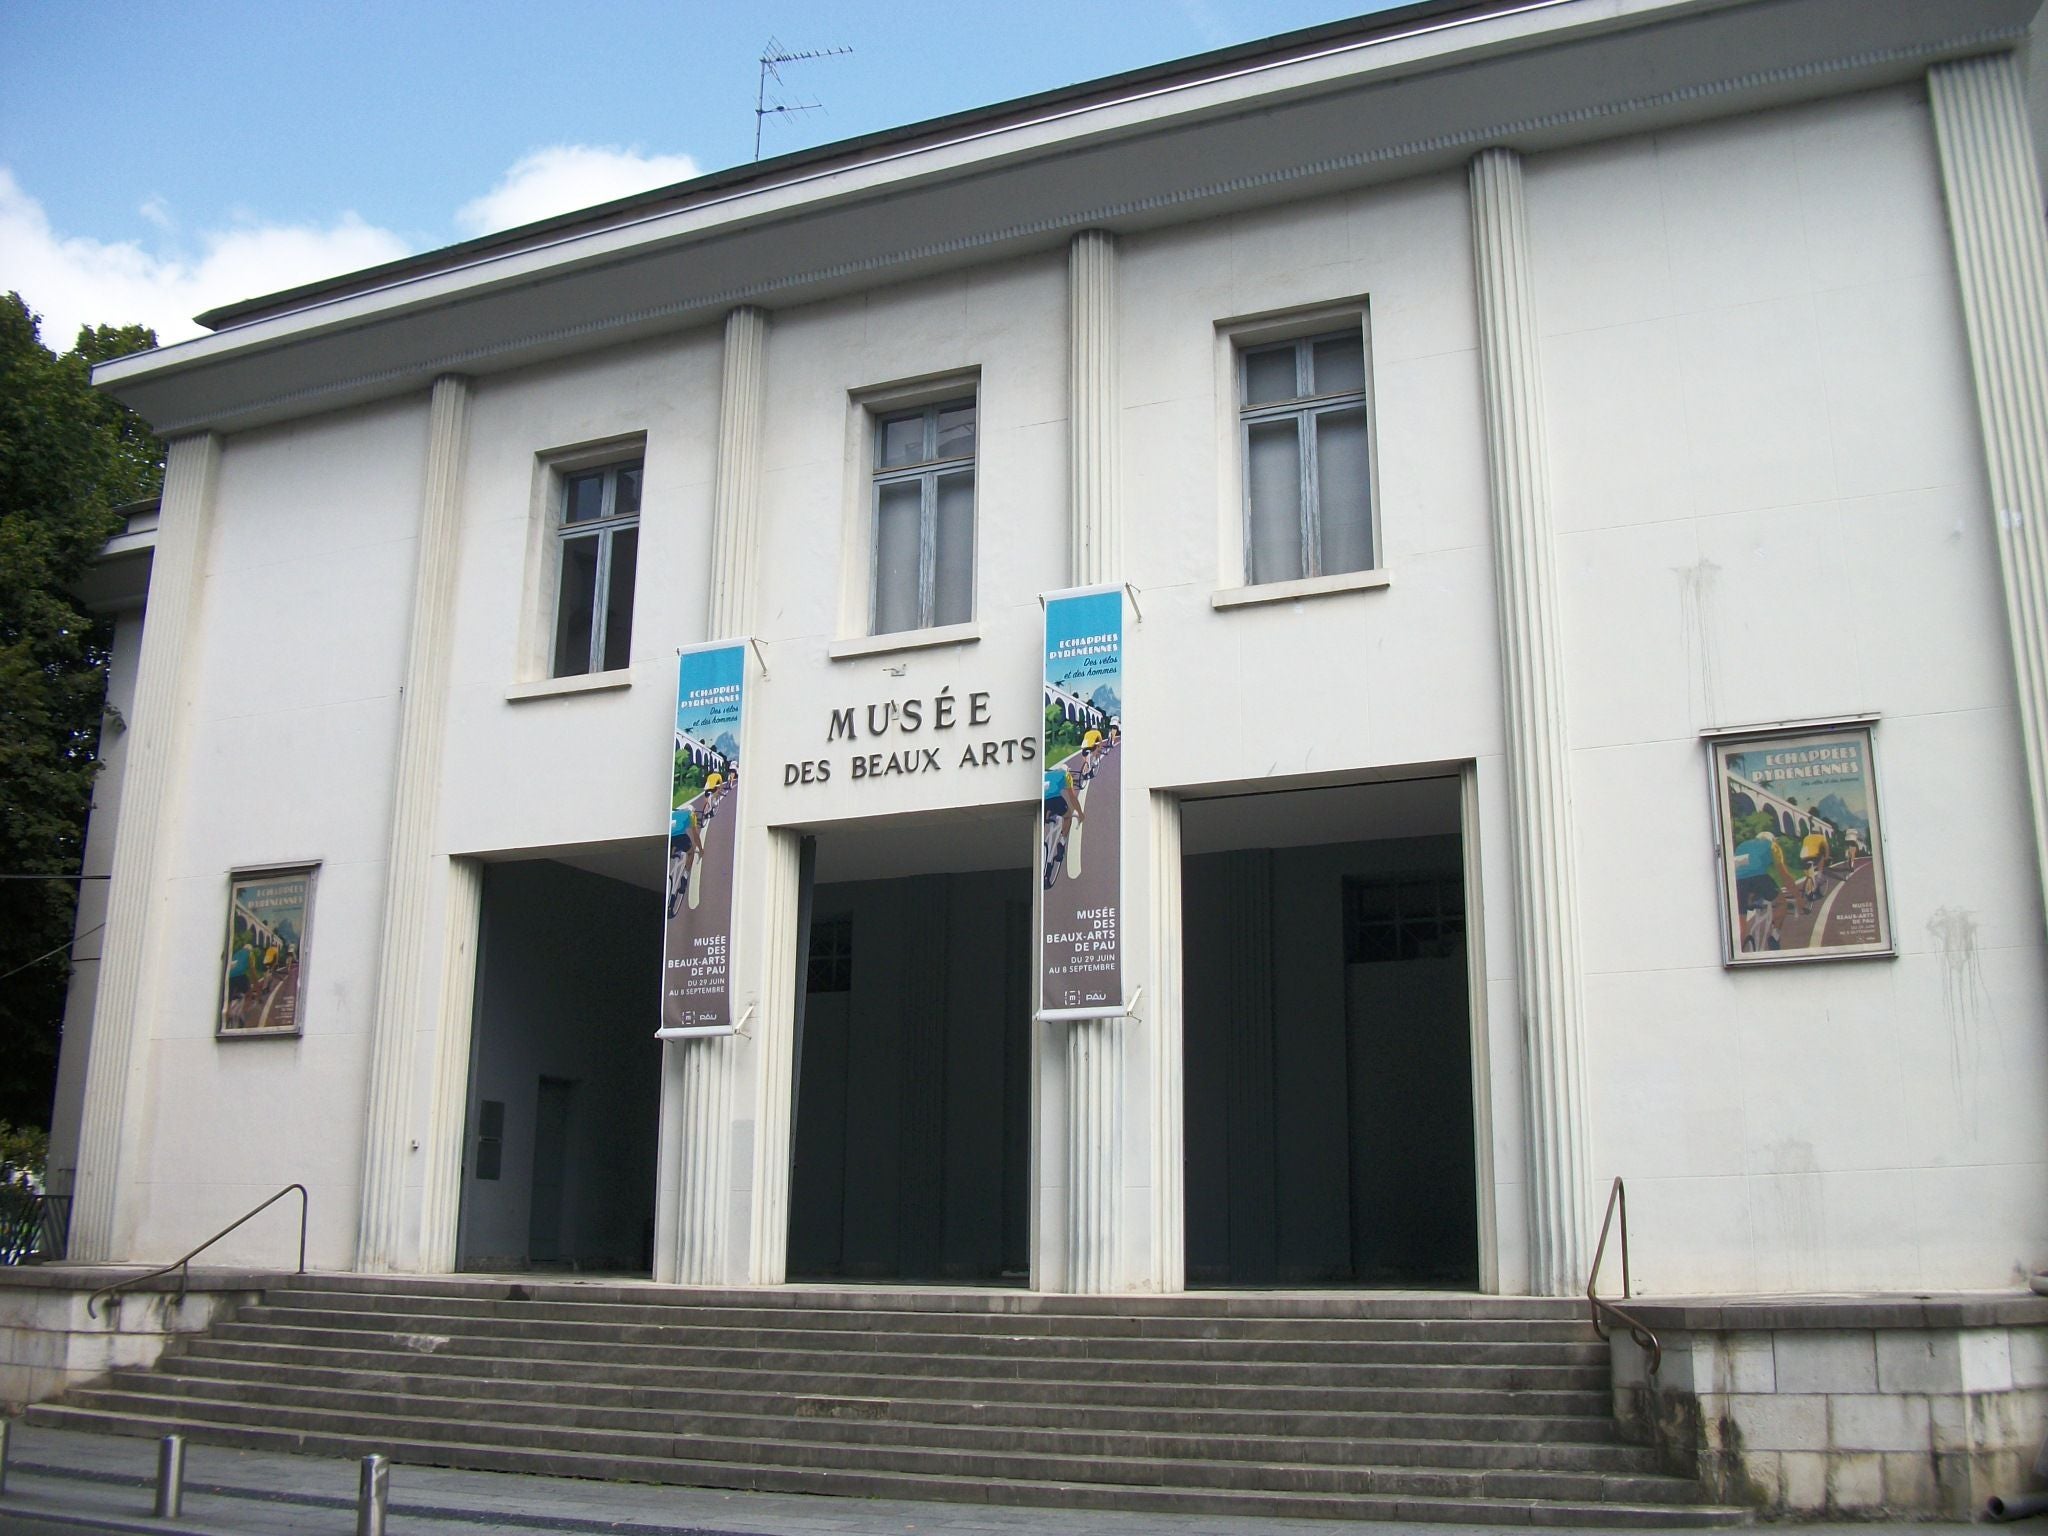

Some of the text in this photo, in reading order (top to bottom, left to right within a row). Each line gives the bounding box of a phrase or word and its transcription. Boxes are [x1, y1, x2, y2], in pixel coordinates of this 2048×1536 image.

[1084, 657, 1097, 667] Des
[1064, 667, 1117, 679] et des hommes
[710, 707, 721, 715] Des
[826, 685, 992, 743] MUSÉE
[700, 718, 711, 726] des
[712, 715, 738, 725] hommes
[784, 736, 1037, 786] DES BEAUX ARTS
[1077, 907, 1115, 919] MUSÉE
[1094, 919, 1115, 929] DES
[694, 934, 726, 946] MUSÉE
[1046, 930, 1115, 943] BEAUX-ARTS
[707, 946, 726, 955] DES
[1075, 941, 1115, 952] DE PAU
[668, 956, 726, 968] BEAUX-ARTS
[1071, 954, 1115, 964] DU 29 JUIN
[691, 966, 726, 976] DE PAU
[1069, 963, 1115, 973] SEPTEMBRE
[688, 979, 697, 987] DU
[699, 978, 708, 986] 29
[686, 986, 725, 995] SEPTEMBRE
